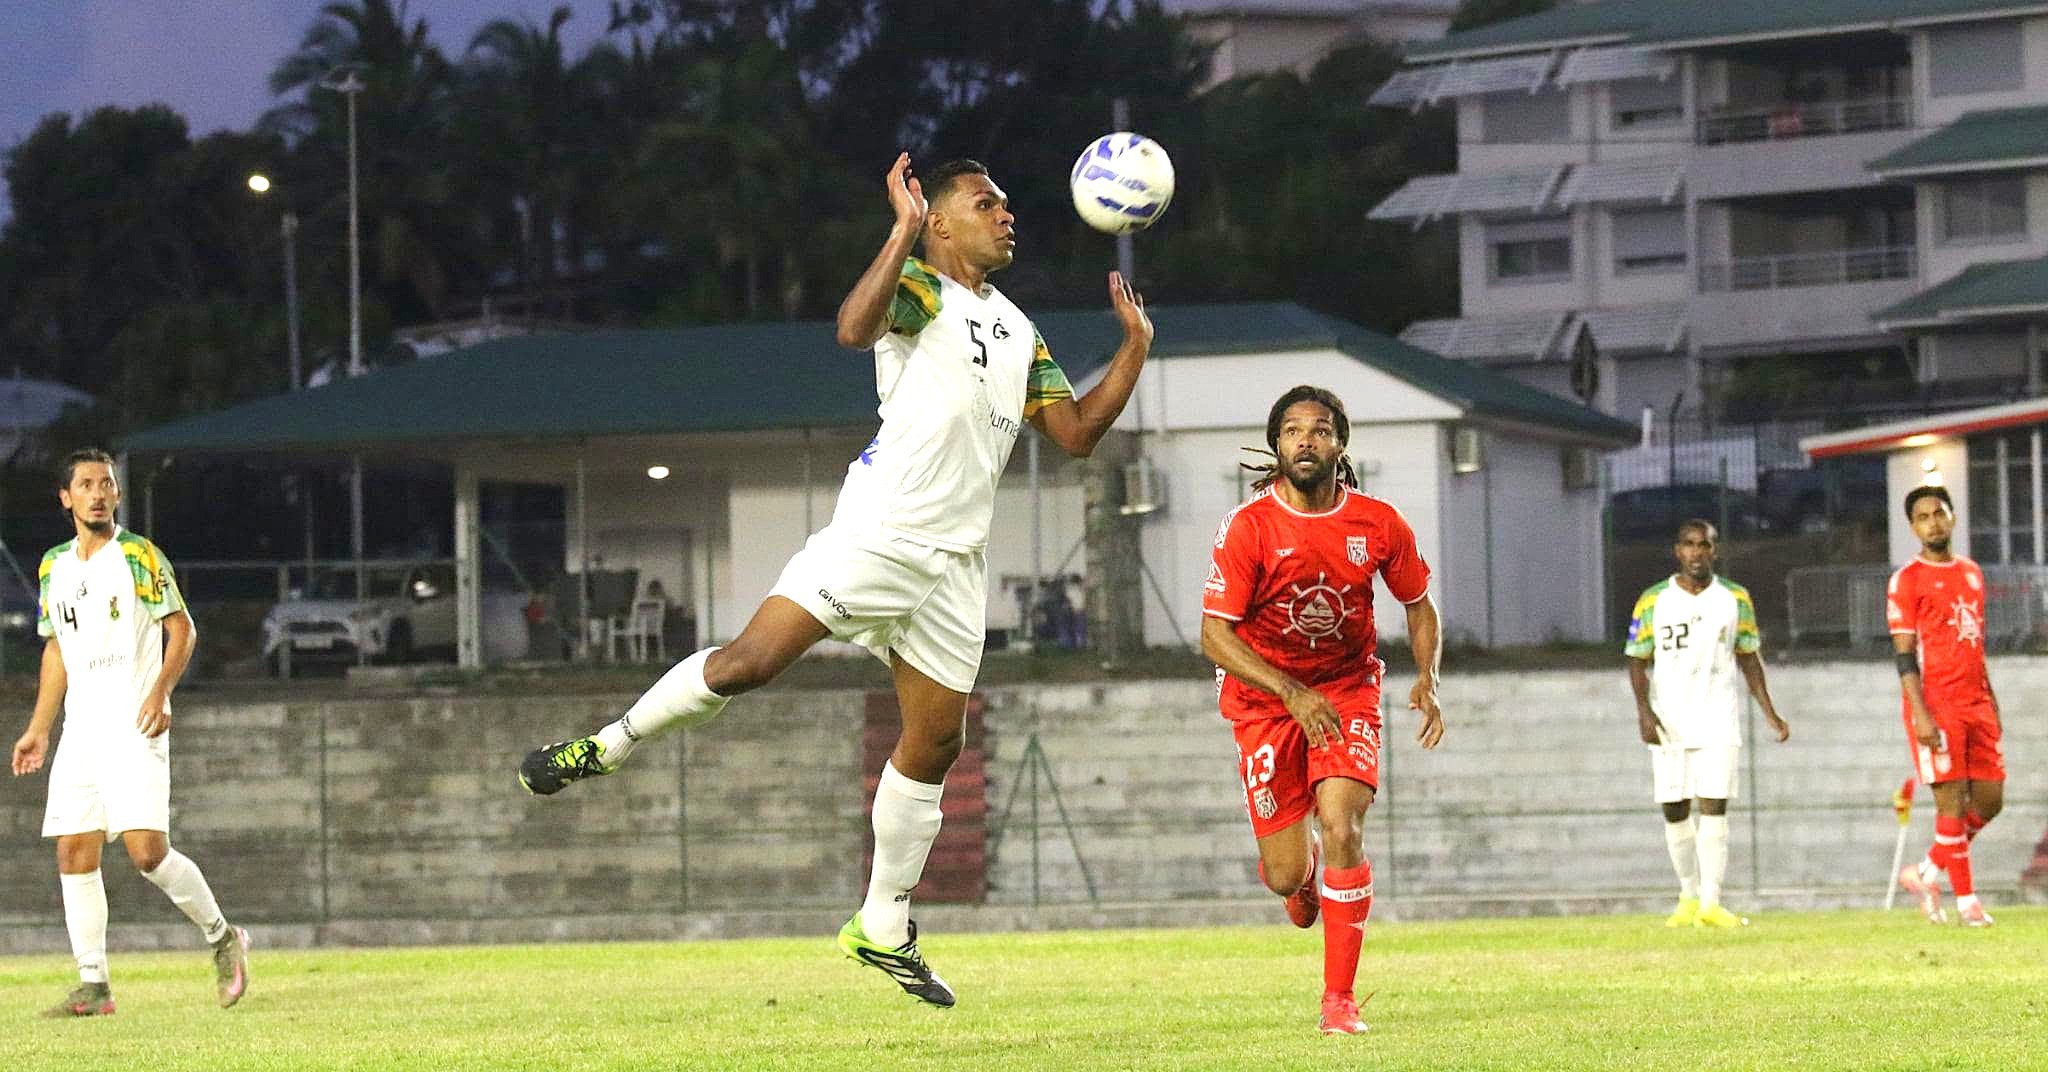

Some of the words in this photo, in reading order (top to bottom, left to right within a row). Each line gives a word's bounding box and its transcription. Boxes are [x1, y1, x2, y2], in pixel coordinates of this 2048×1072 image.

[57, 601, 78, 635] 14
[1661, 623, 1689, 651] 22
[1246, 743, 1276, 790] 23
